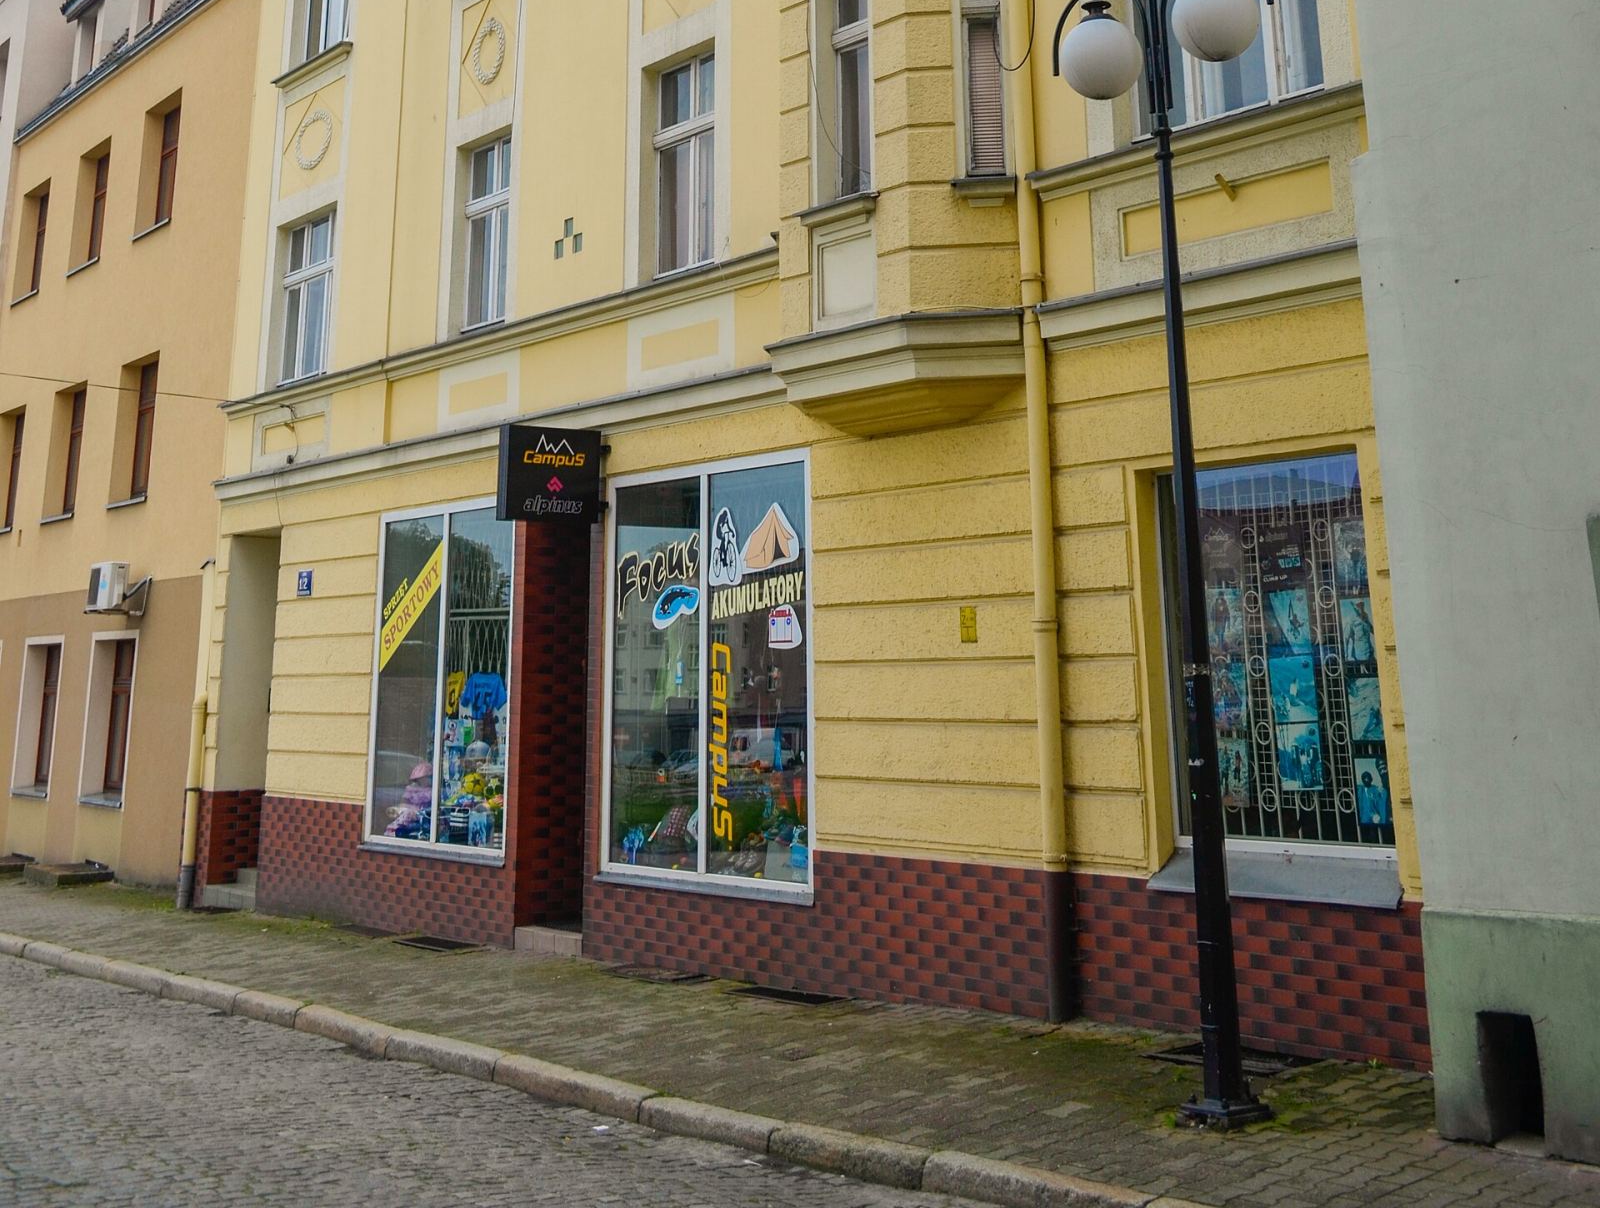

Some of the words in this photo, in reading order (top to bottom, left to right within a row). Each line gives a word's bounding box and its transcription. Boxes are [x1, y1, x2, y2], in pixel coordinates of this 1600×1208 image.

[523, 494, 583, 515] alpinus
[299, 577, 308, 590] 12
[711, 571, 804, 620] AKUMULATORY
[383, 559, 440, 651] SPORTOWY
